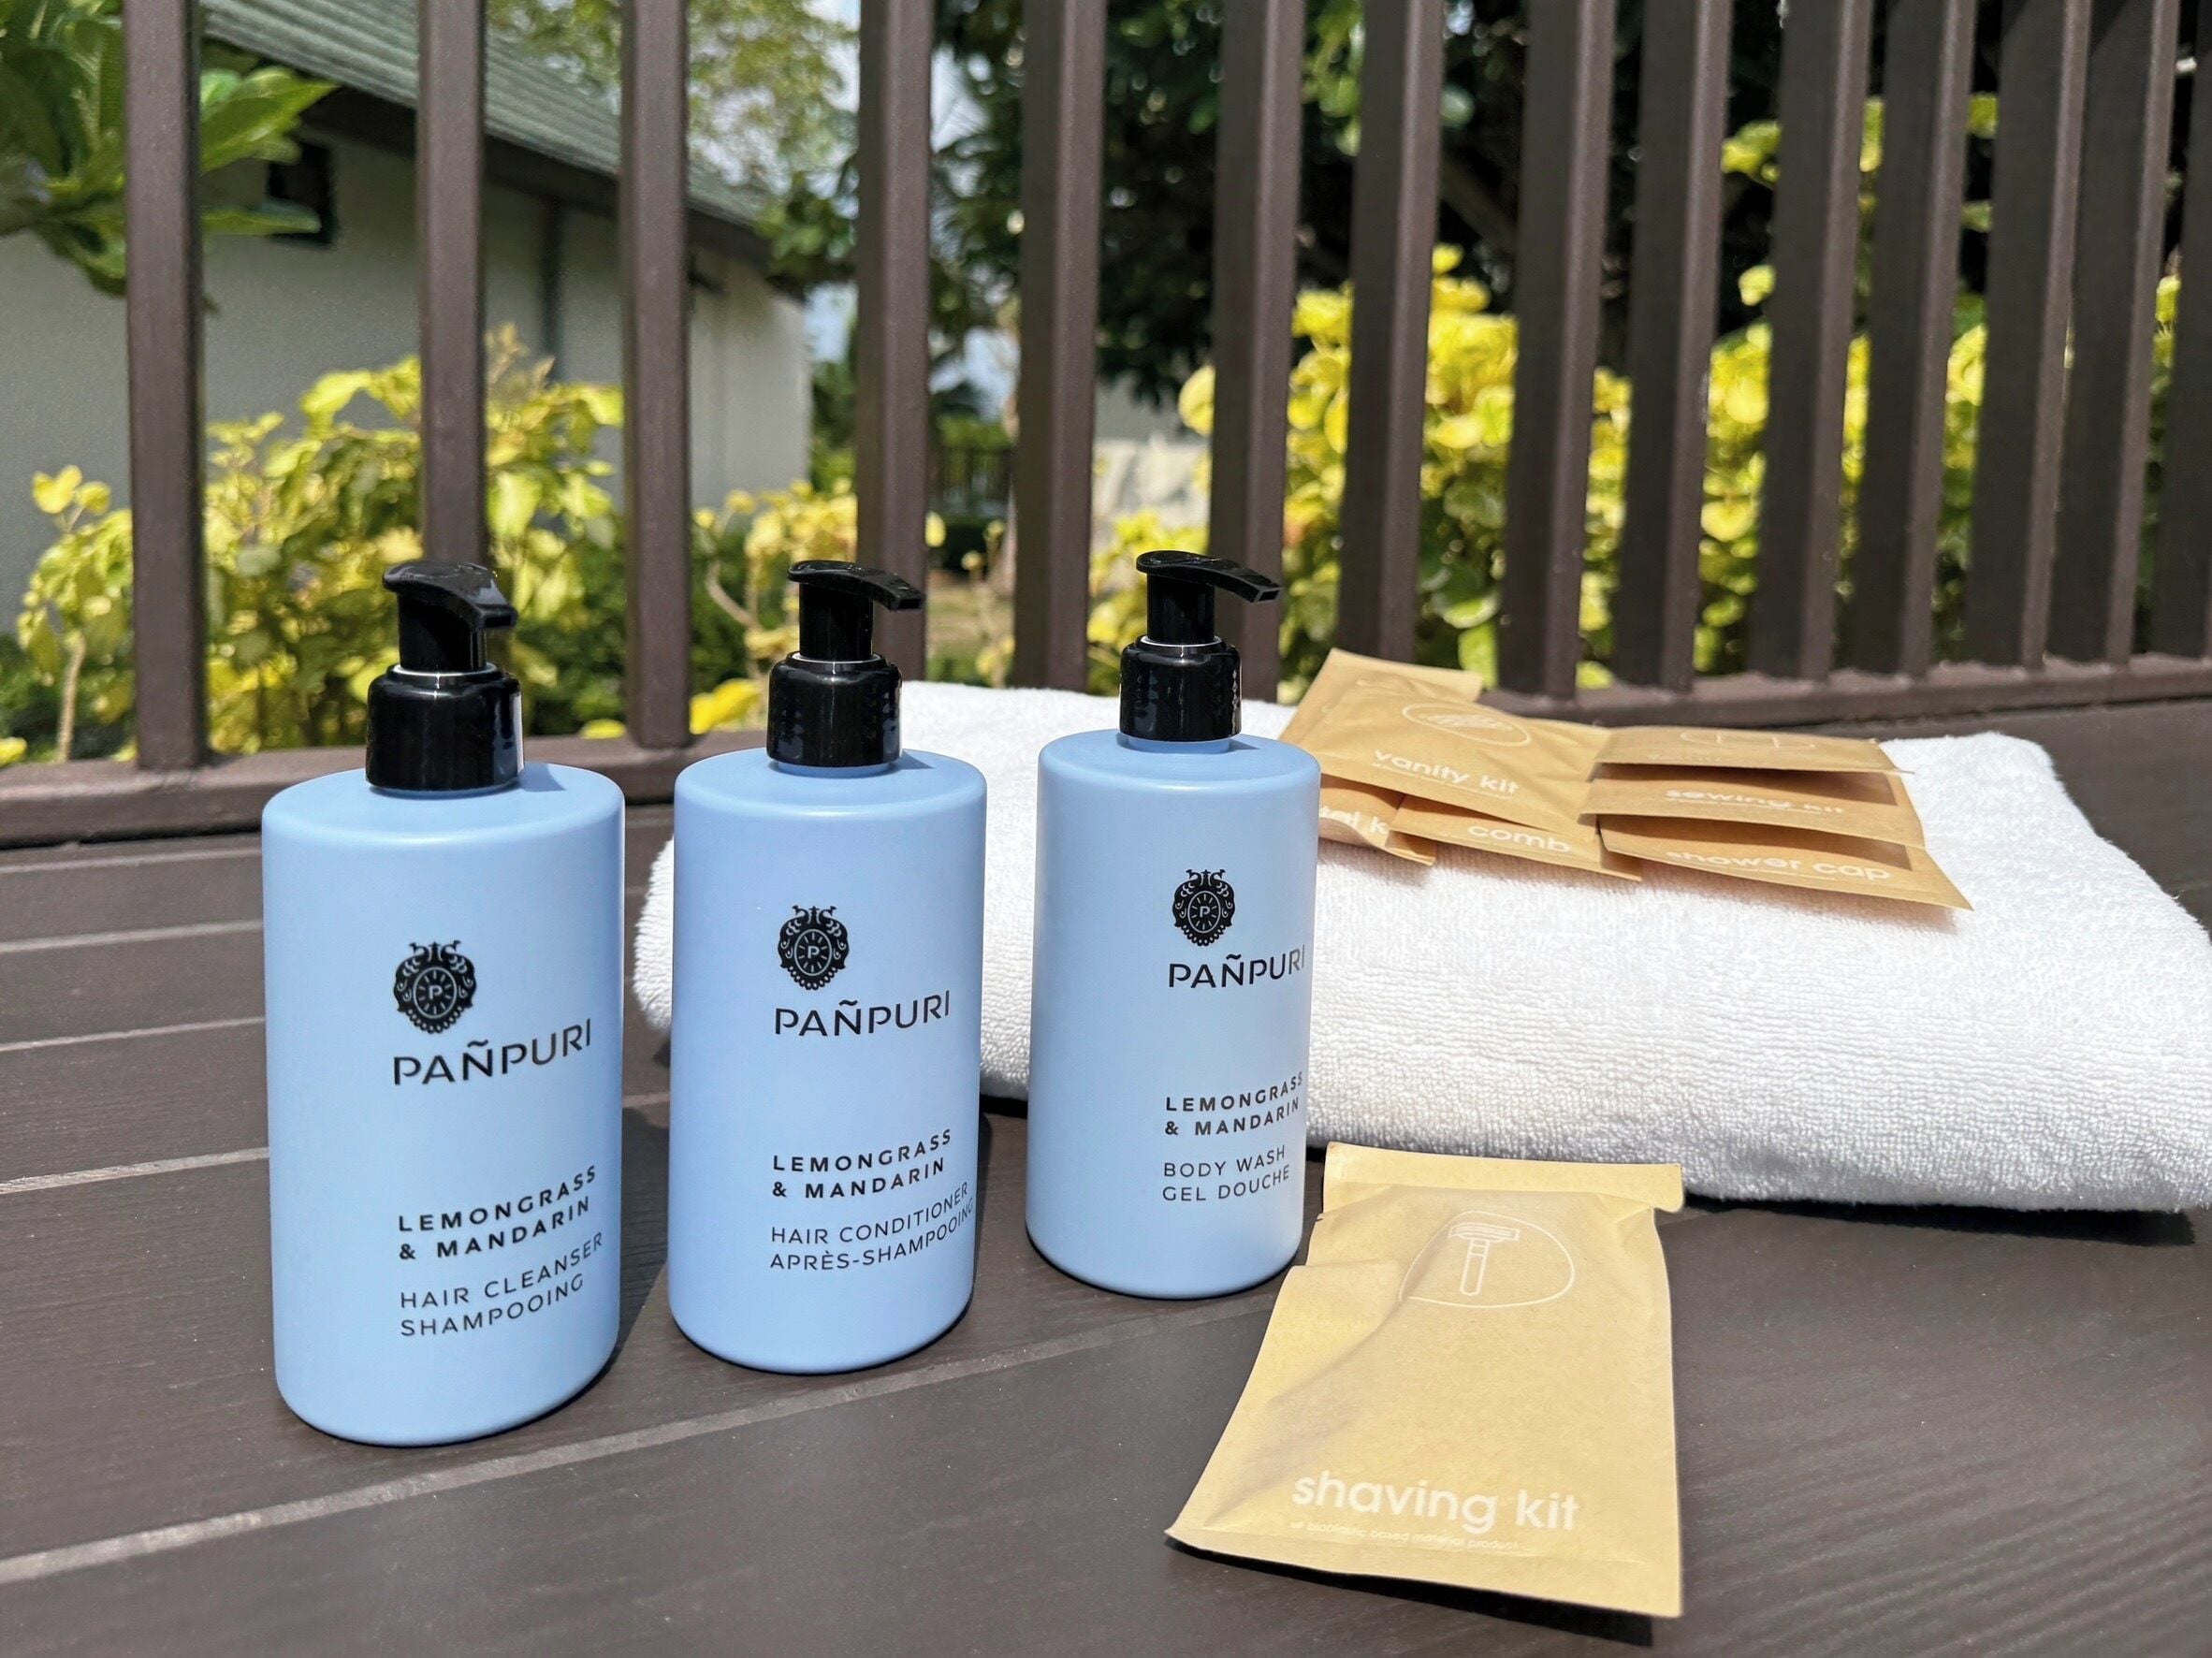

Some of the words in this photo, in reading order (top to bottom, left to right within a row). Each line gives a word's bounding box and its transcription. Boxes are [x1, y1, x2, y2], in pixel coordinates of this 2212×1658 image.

[1375, 749, 1469, 783] vanity
[1480, 775, 1519, 793] kit
[1466, 825, 1573, 852] comb
[1665, 851, 1801, 870] shower
[1812, 863, 1892, 880] cap
[1169, 944, 1305, 988] PAÑPURI
[775, 990, 950, 1036] PAÑPURI
[394, 1018, 590, 1085] PAÑPURI
[1166, 1070, 1302, 1112] LEMONGRASS
[1165, 1121, 1179, 1135] &
[1195, 1097, 1299, 1135] MANDARIN
[774, 1129, 951, 1171] LEMONGRASS
[1164, 1161, 1227, 1177] BODY
[1236, 1145, 1285, 1172] WASH
[399, 1166, 596, 1231] LEMONGRASS
[772, 1182, 787, 1197] &
[805, 1157, 944, 1198] MANDARIN
[1162, 1186, 1206, 1201] GEL
[1218, 1165, 1289, 1200] DOUCHE
[399, 1244, 416, 1260] &
[437, 1196, 589, 1258] MANDARIN
[770, 1197, 973, 1271] APRÈS-SHAMPOOING
[771, 1227, 829, 1244] HAIR
[839, 1182, 968, 1243] CONDITIONER
[400, 1287, 470, 1309] HAIR
[484, 1232, 603, 1299] CLEANSER
[400, 1273, 583, 1337] SHAMPOOING
[1291, 1470, 1496, 1534] shaving
[1515, 1489, 1579, 1531] kit
